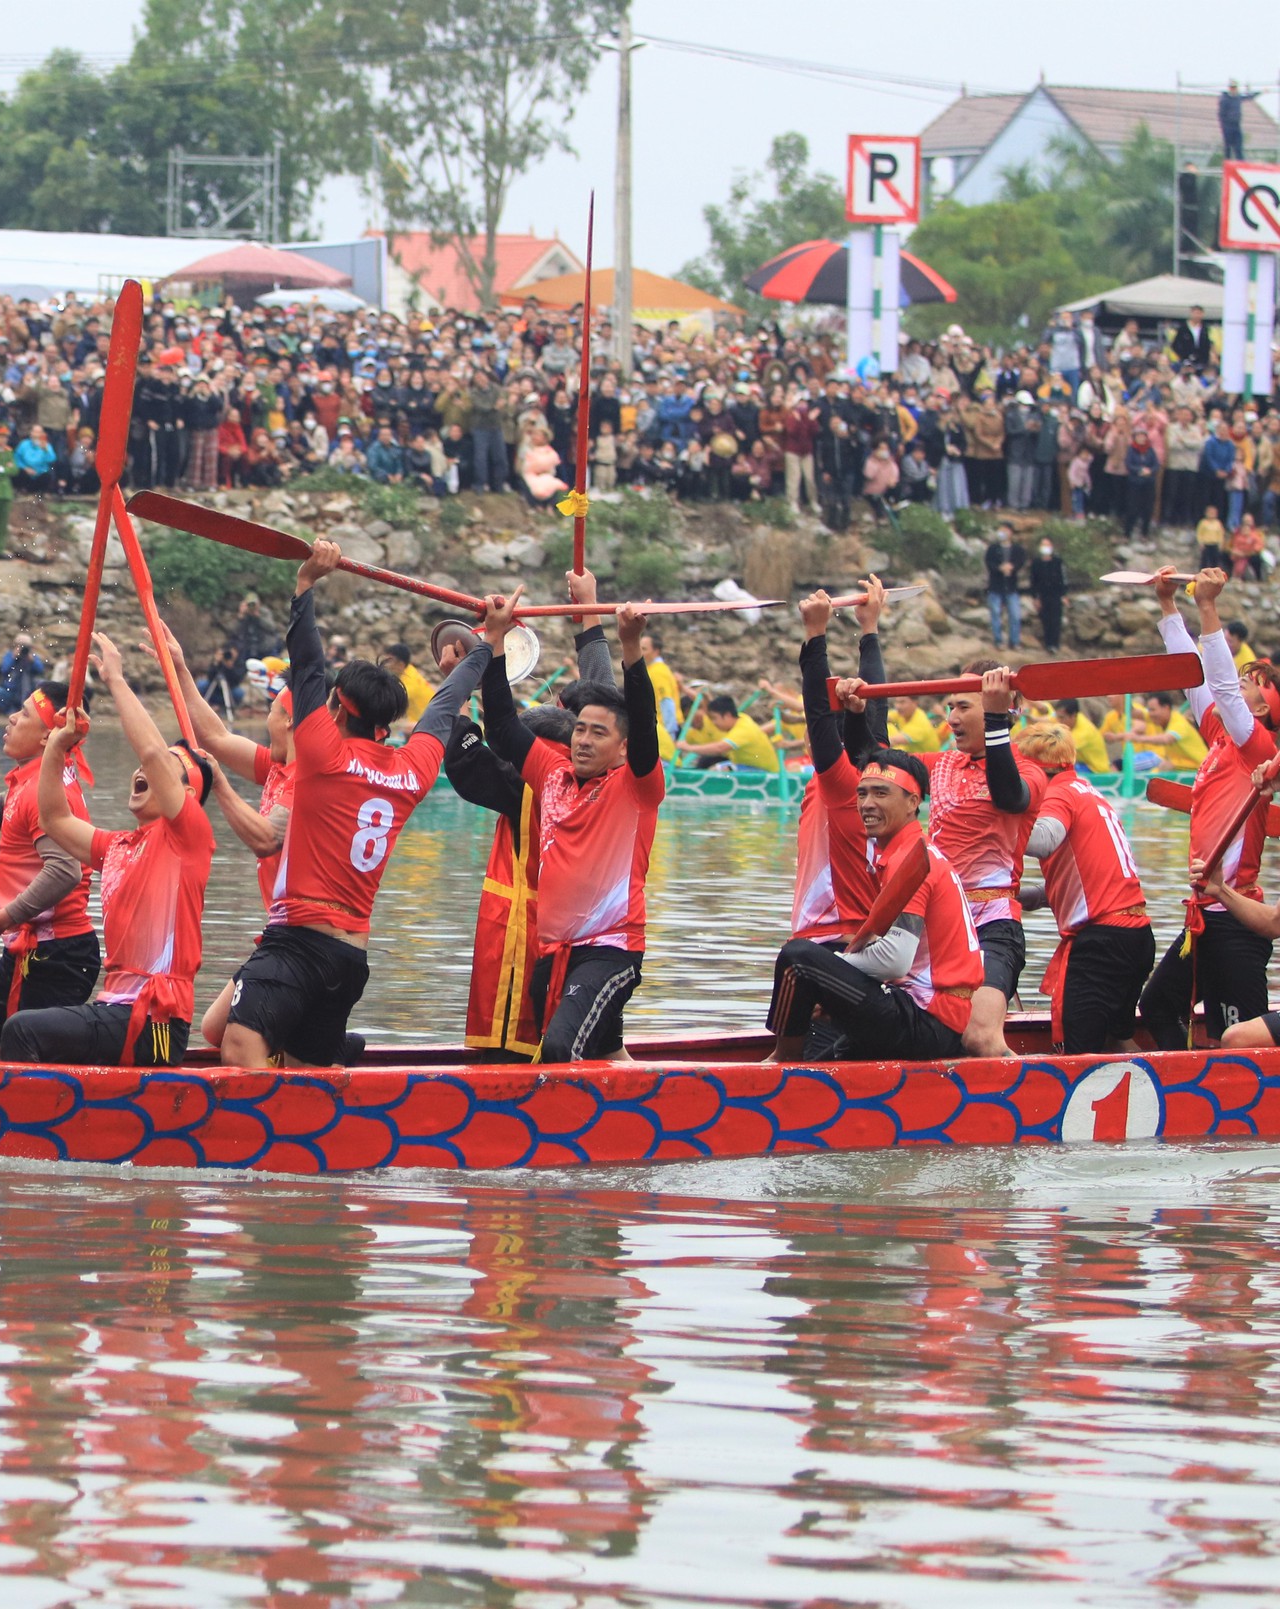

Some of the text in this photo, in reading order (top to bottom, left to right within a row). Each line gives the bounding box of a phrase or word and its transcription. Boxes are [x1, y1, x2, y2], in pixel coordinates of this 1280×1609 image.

[869, 153, 897, 202] P
[350, 797, 394, 873] 8
[1220, 1002, 1240, 1028] 18
[1091, 1071, 1131, 1142] 1
